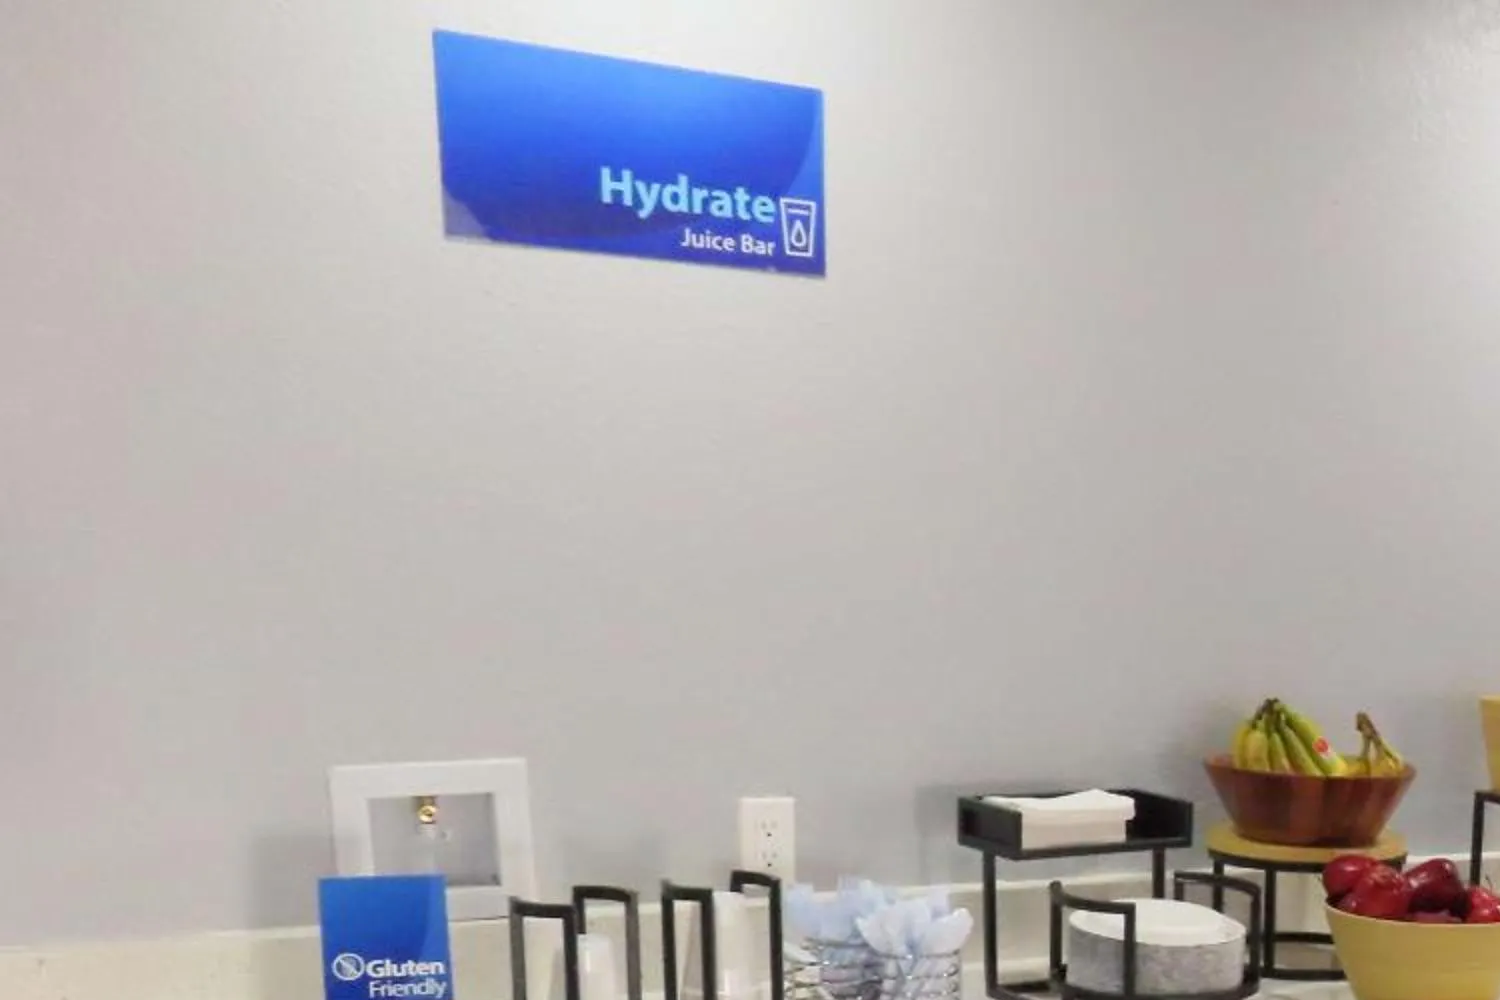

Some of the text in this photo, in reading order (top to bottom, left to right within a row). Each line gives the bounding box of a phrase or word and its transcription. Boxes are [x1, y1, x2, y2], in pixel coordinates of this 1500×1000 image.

[601, 166, 777, 222] Hydrate
[680, 227, 776, 257] Juice Bar
[366, 957, 446, 979] Gluten
[369, 977, 447, 999] Friendly
